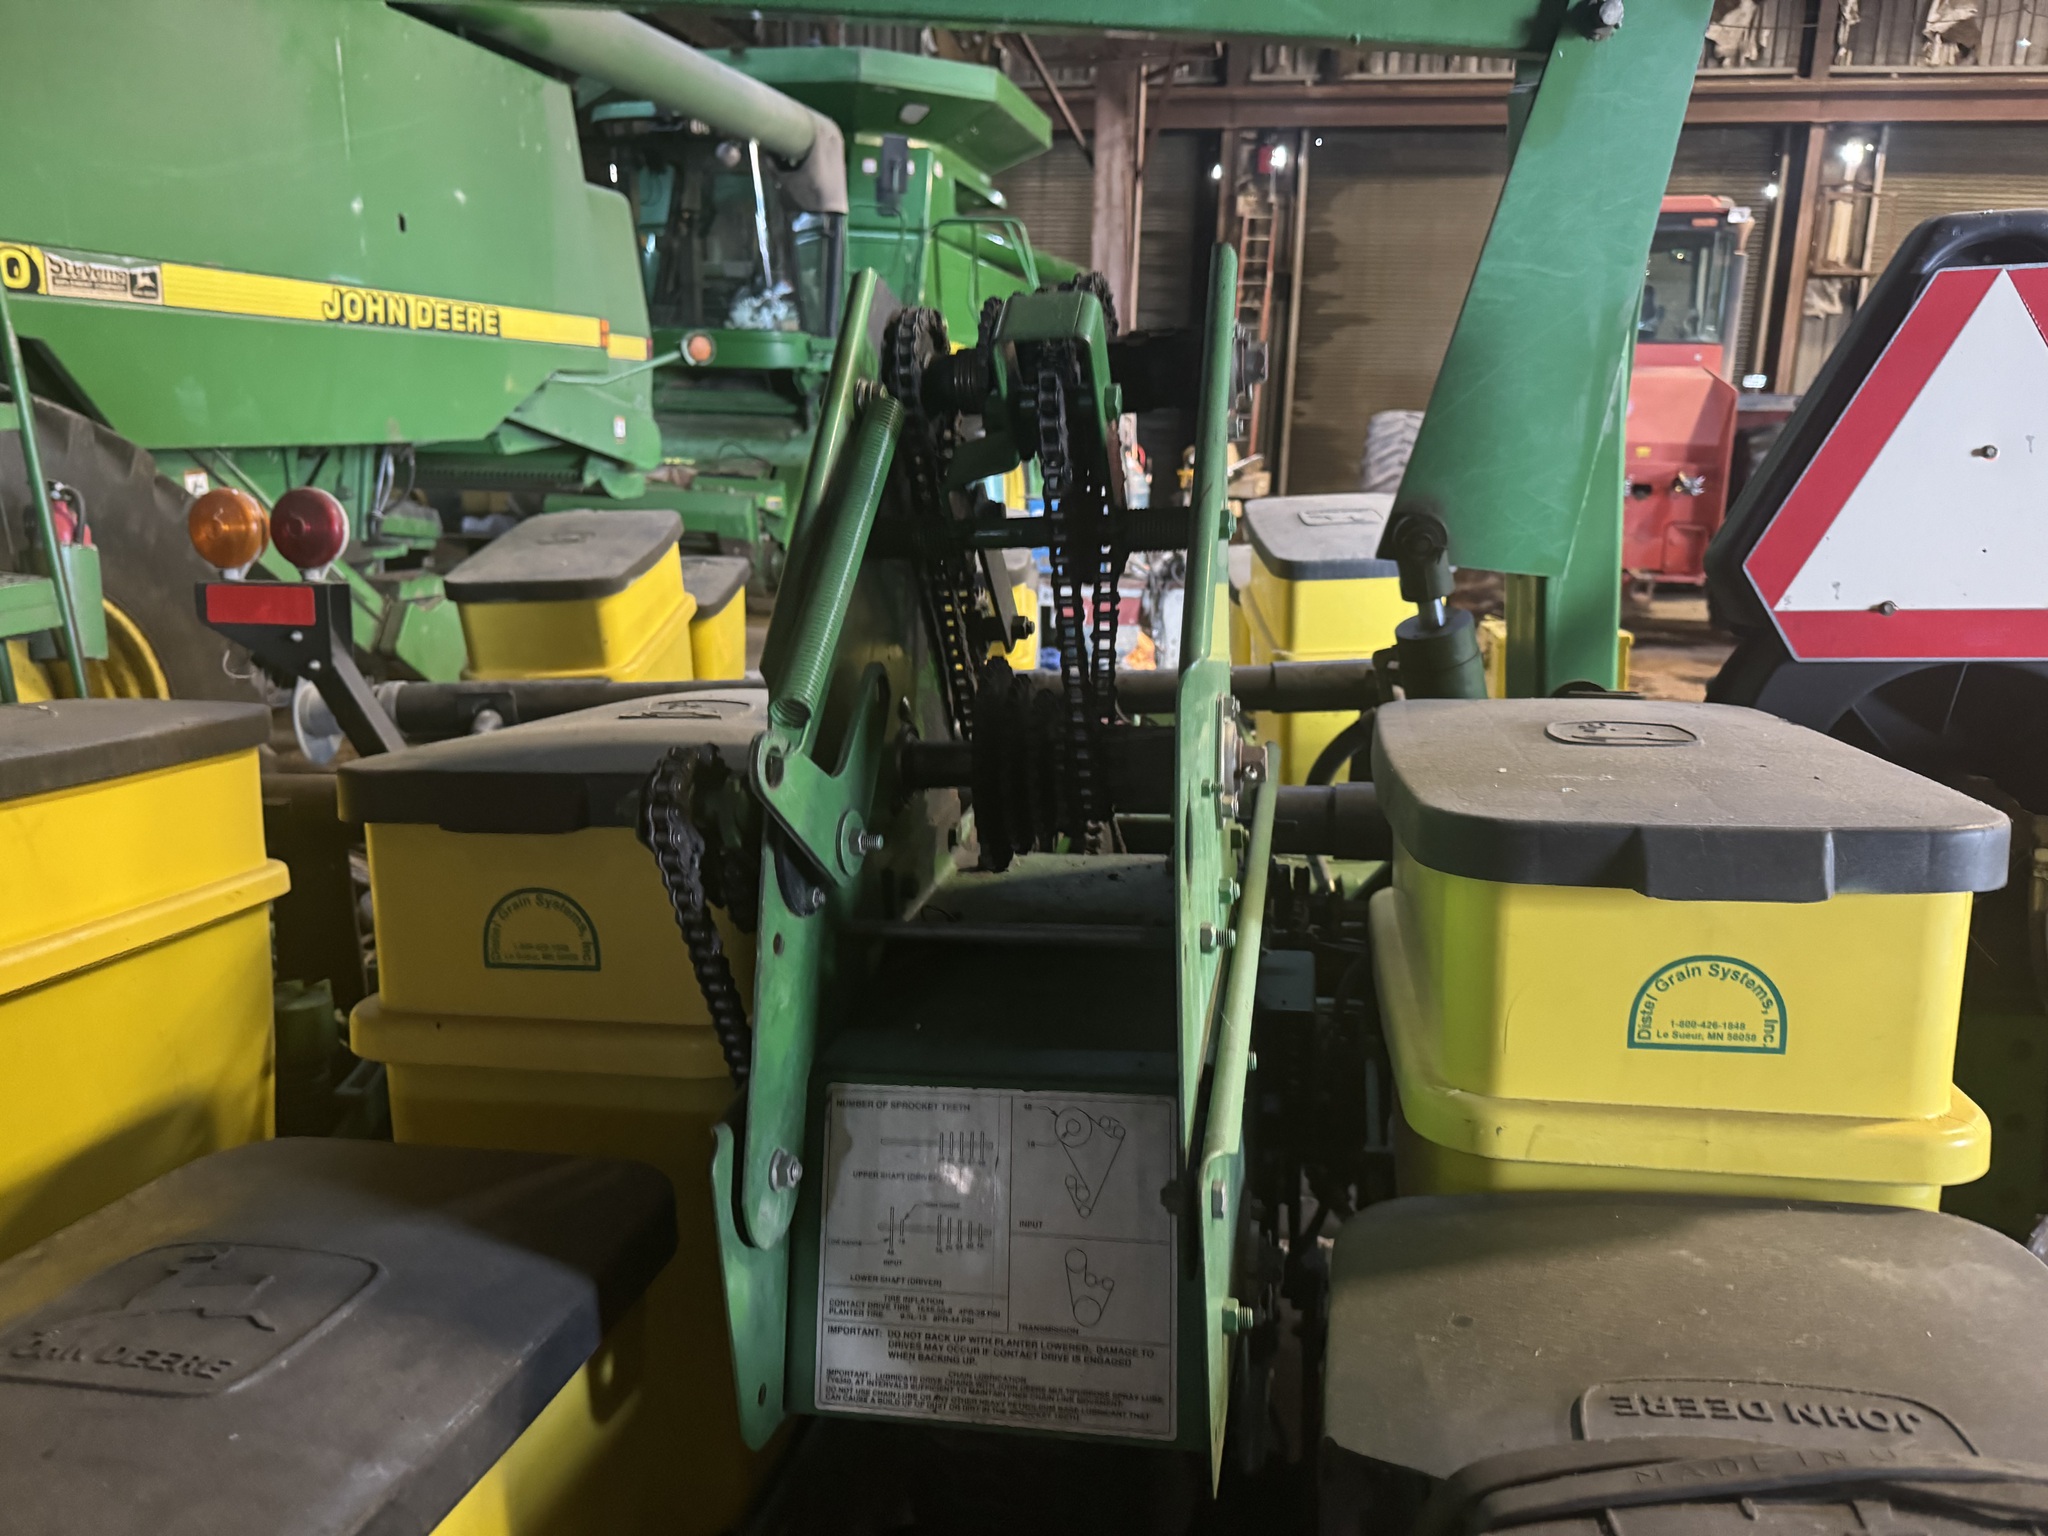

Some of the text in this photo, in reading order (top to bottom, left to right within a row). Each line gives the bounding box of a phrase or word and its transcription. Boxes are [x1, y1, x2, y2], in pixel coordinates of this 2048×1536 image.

[322, 287, 500, 338] JOHN DEERE
[1637, 963, 1779, 1047] Distel Grain Systems, Inc.
[1657, 1030, 1670, 1039] Le
[1707, 1032, 1724, 1041] MN
[836, 1100, 874, 1109] NUMBER
[876, 1101, 888, 1109] OF
[890, 1101, 938, 1111] SPROCKET
[852, 1170, 880, 1180] UPPER
[1019, 1220, 1043, 1229] INPUT
[850, 1274, 879, 1283] LOWER
[880, 1275, 906, 1285] SHAFT
[829, 1299, 866, 1309] CONTACT
[867, 1301, 891, 1310] DRIVE
[829, 1308, 865, 1317] PLANTER
[1018, 1323, 1079, 1335] TRANSMISSION
[827, 1325, 882, 1338] IMPORTANT:
[887, 1329, 901, 1338] DO
[903, 1330, 922, 1340] NOT
[925, 1332, 950, 1342] BACK
[953, 1333, 966, 1343] UP
[968, 1335, 992, 1345] WITH
[995, 1337, 1038, 1349] PLANTER
[1096, 1344, 1139, 1357] DAMAGE
[1142, 1349, 1155, 1359] TO
[888, 1340, 922, 1350] DRIVES
[923, 1342, 945, 1352] MAY
[946, 1343, 980, 1355] OCCUR
[982, 1347, 990, 1356] IF
[993, 1348, 1038, 1361] CONTACT
[1040, 1352, 1069, 1363] DRIVE
[1071, 1355, 1082, 1364] IS
[888, 1351, 916, 1361] WHEN
[918, 1353, 960, 1364] BACKING
[838, 1386, 854, 1394] NOT
[1609, 1395, 1922, 1435] JOHN DEERE
[1634, 1453, 1771, 1485] MADE
[1799, 1447, 1847, 1468] IN
